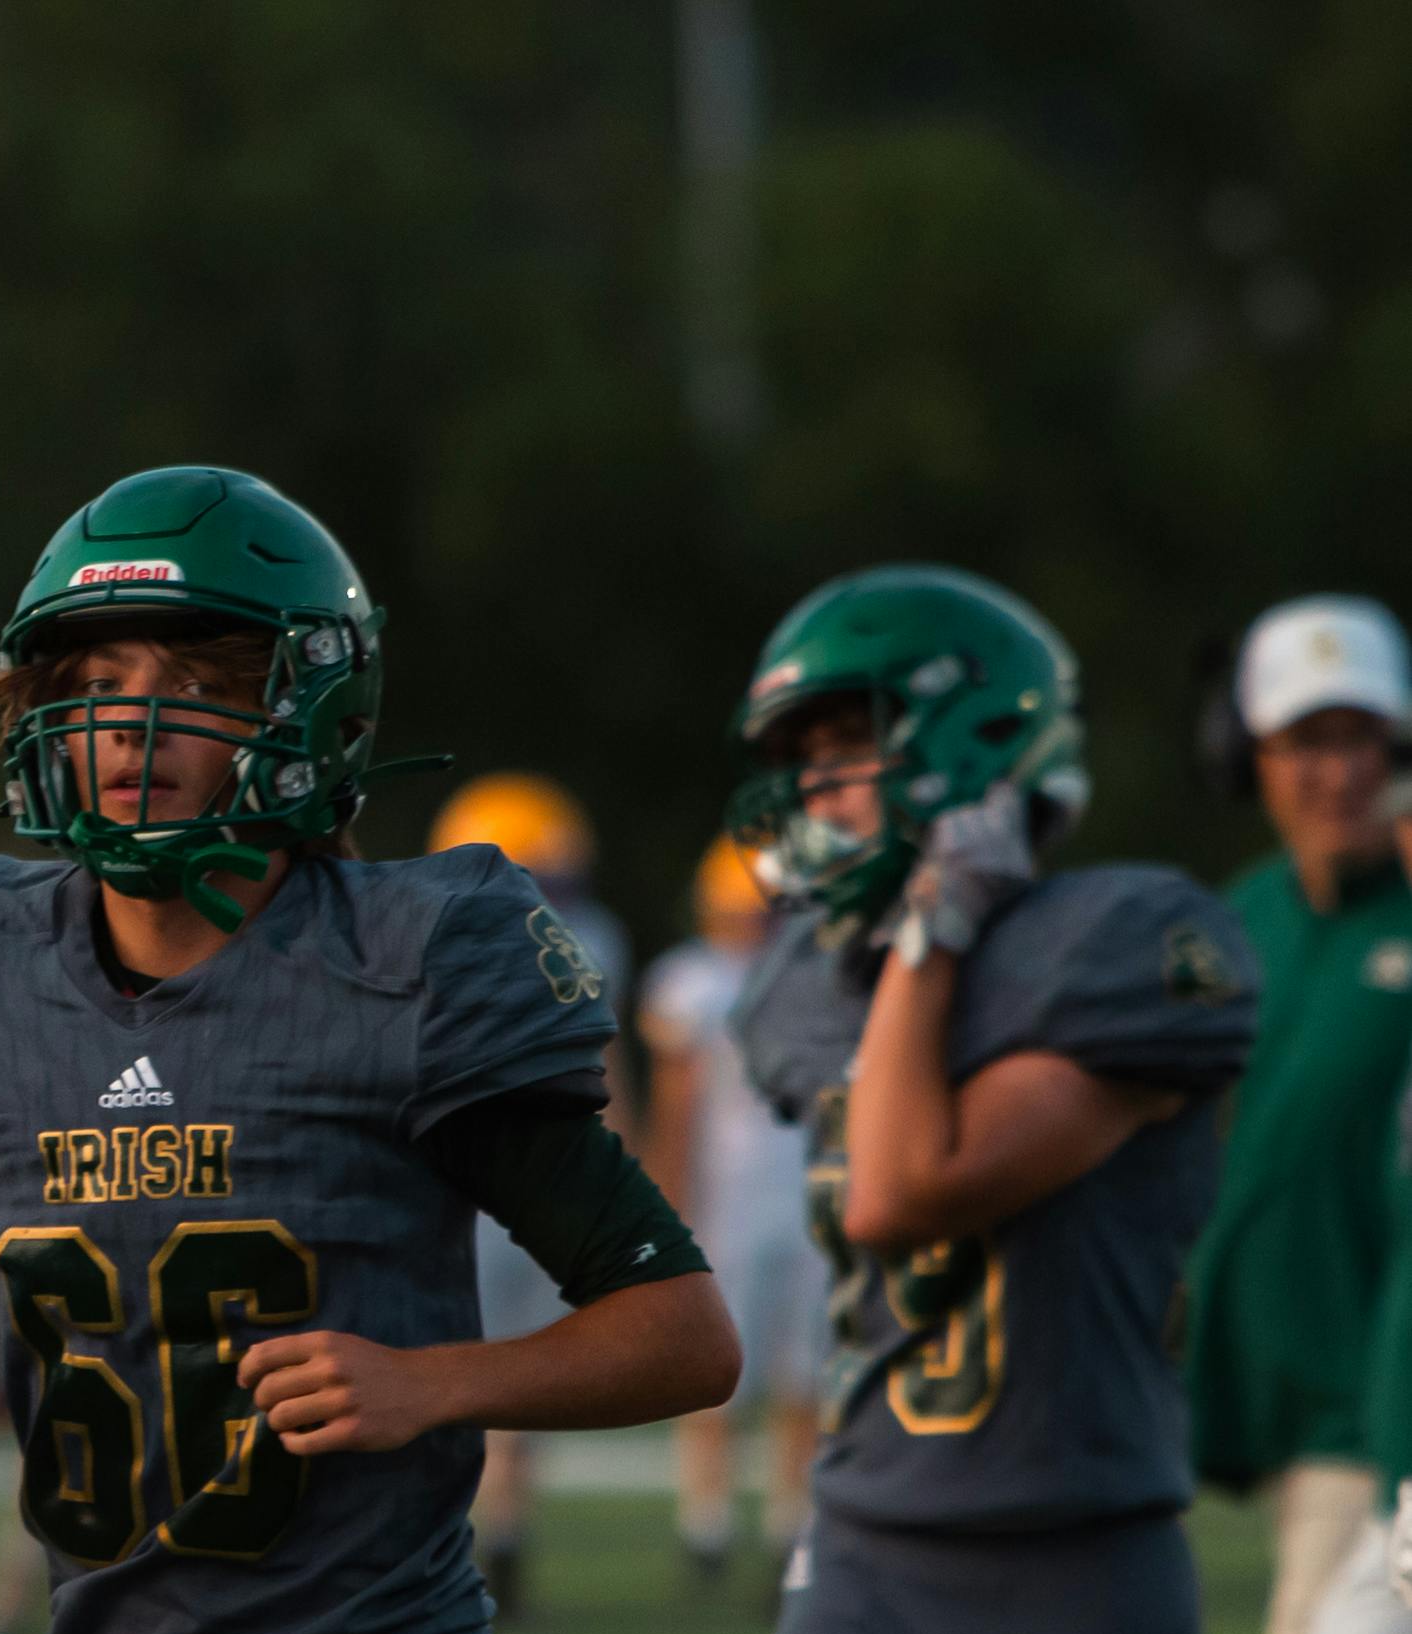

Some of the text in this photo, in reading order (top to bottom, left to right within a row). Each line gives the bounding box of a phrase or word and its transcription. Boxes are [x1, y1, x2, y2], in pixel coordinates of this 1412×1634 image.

[79, 555, 170, 586] Riddell
[97, 1086, 175, 1109] adidas
[37, 1123, 235, 1203] IRISH
